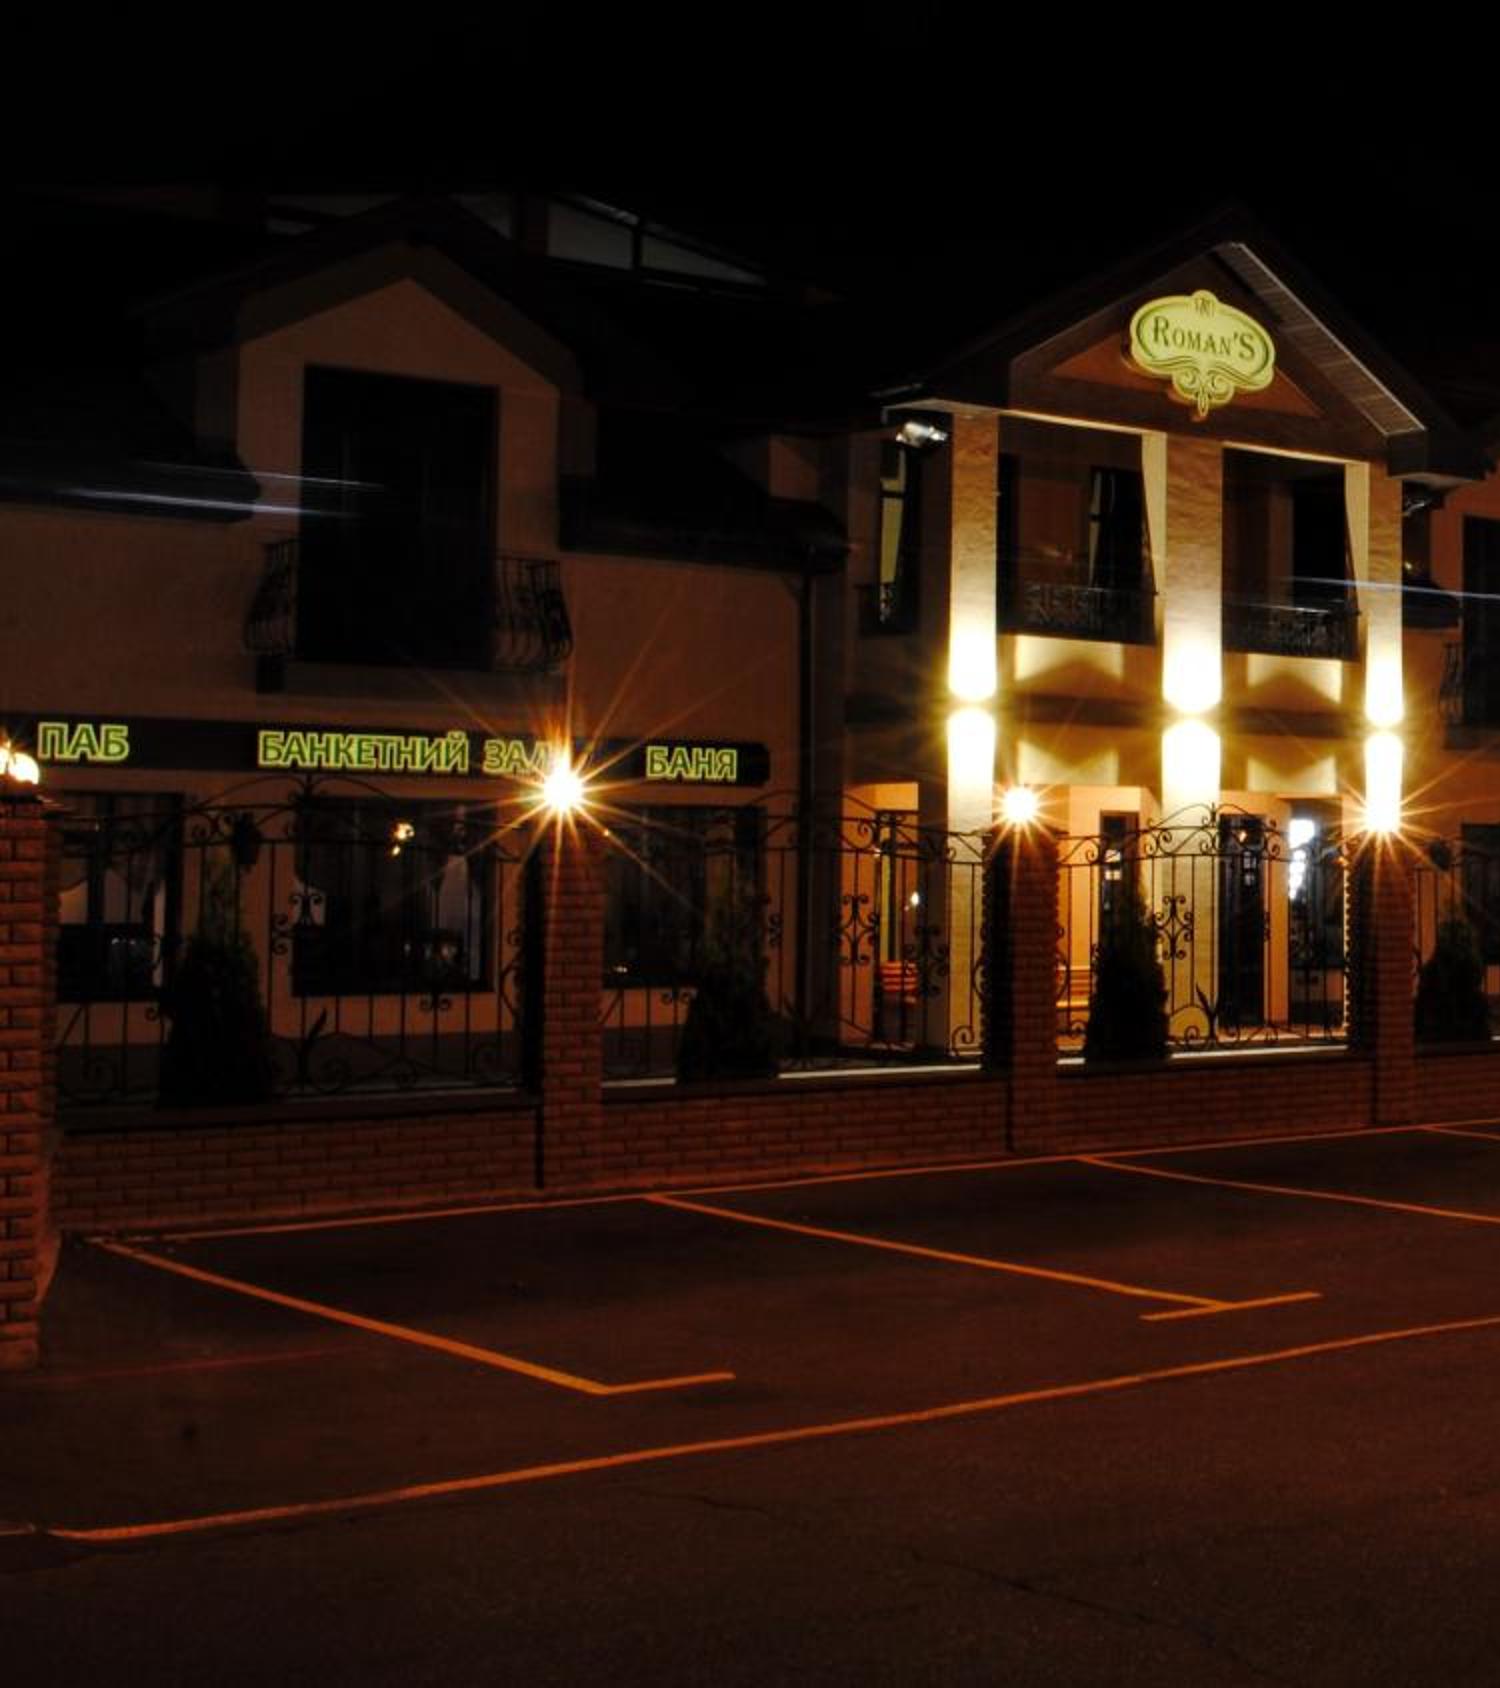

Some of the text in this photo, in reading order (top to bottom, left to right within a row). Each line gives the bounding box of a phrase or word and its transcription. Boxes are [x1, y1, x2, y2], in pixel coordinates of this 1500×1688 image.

[37, 722, 130, 762] ПАБ
[258, 730, 469, 774] БАНКЕТНИЙ
[646, 745, 737, 781] БАНЯ
